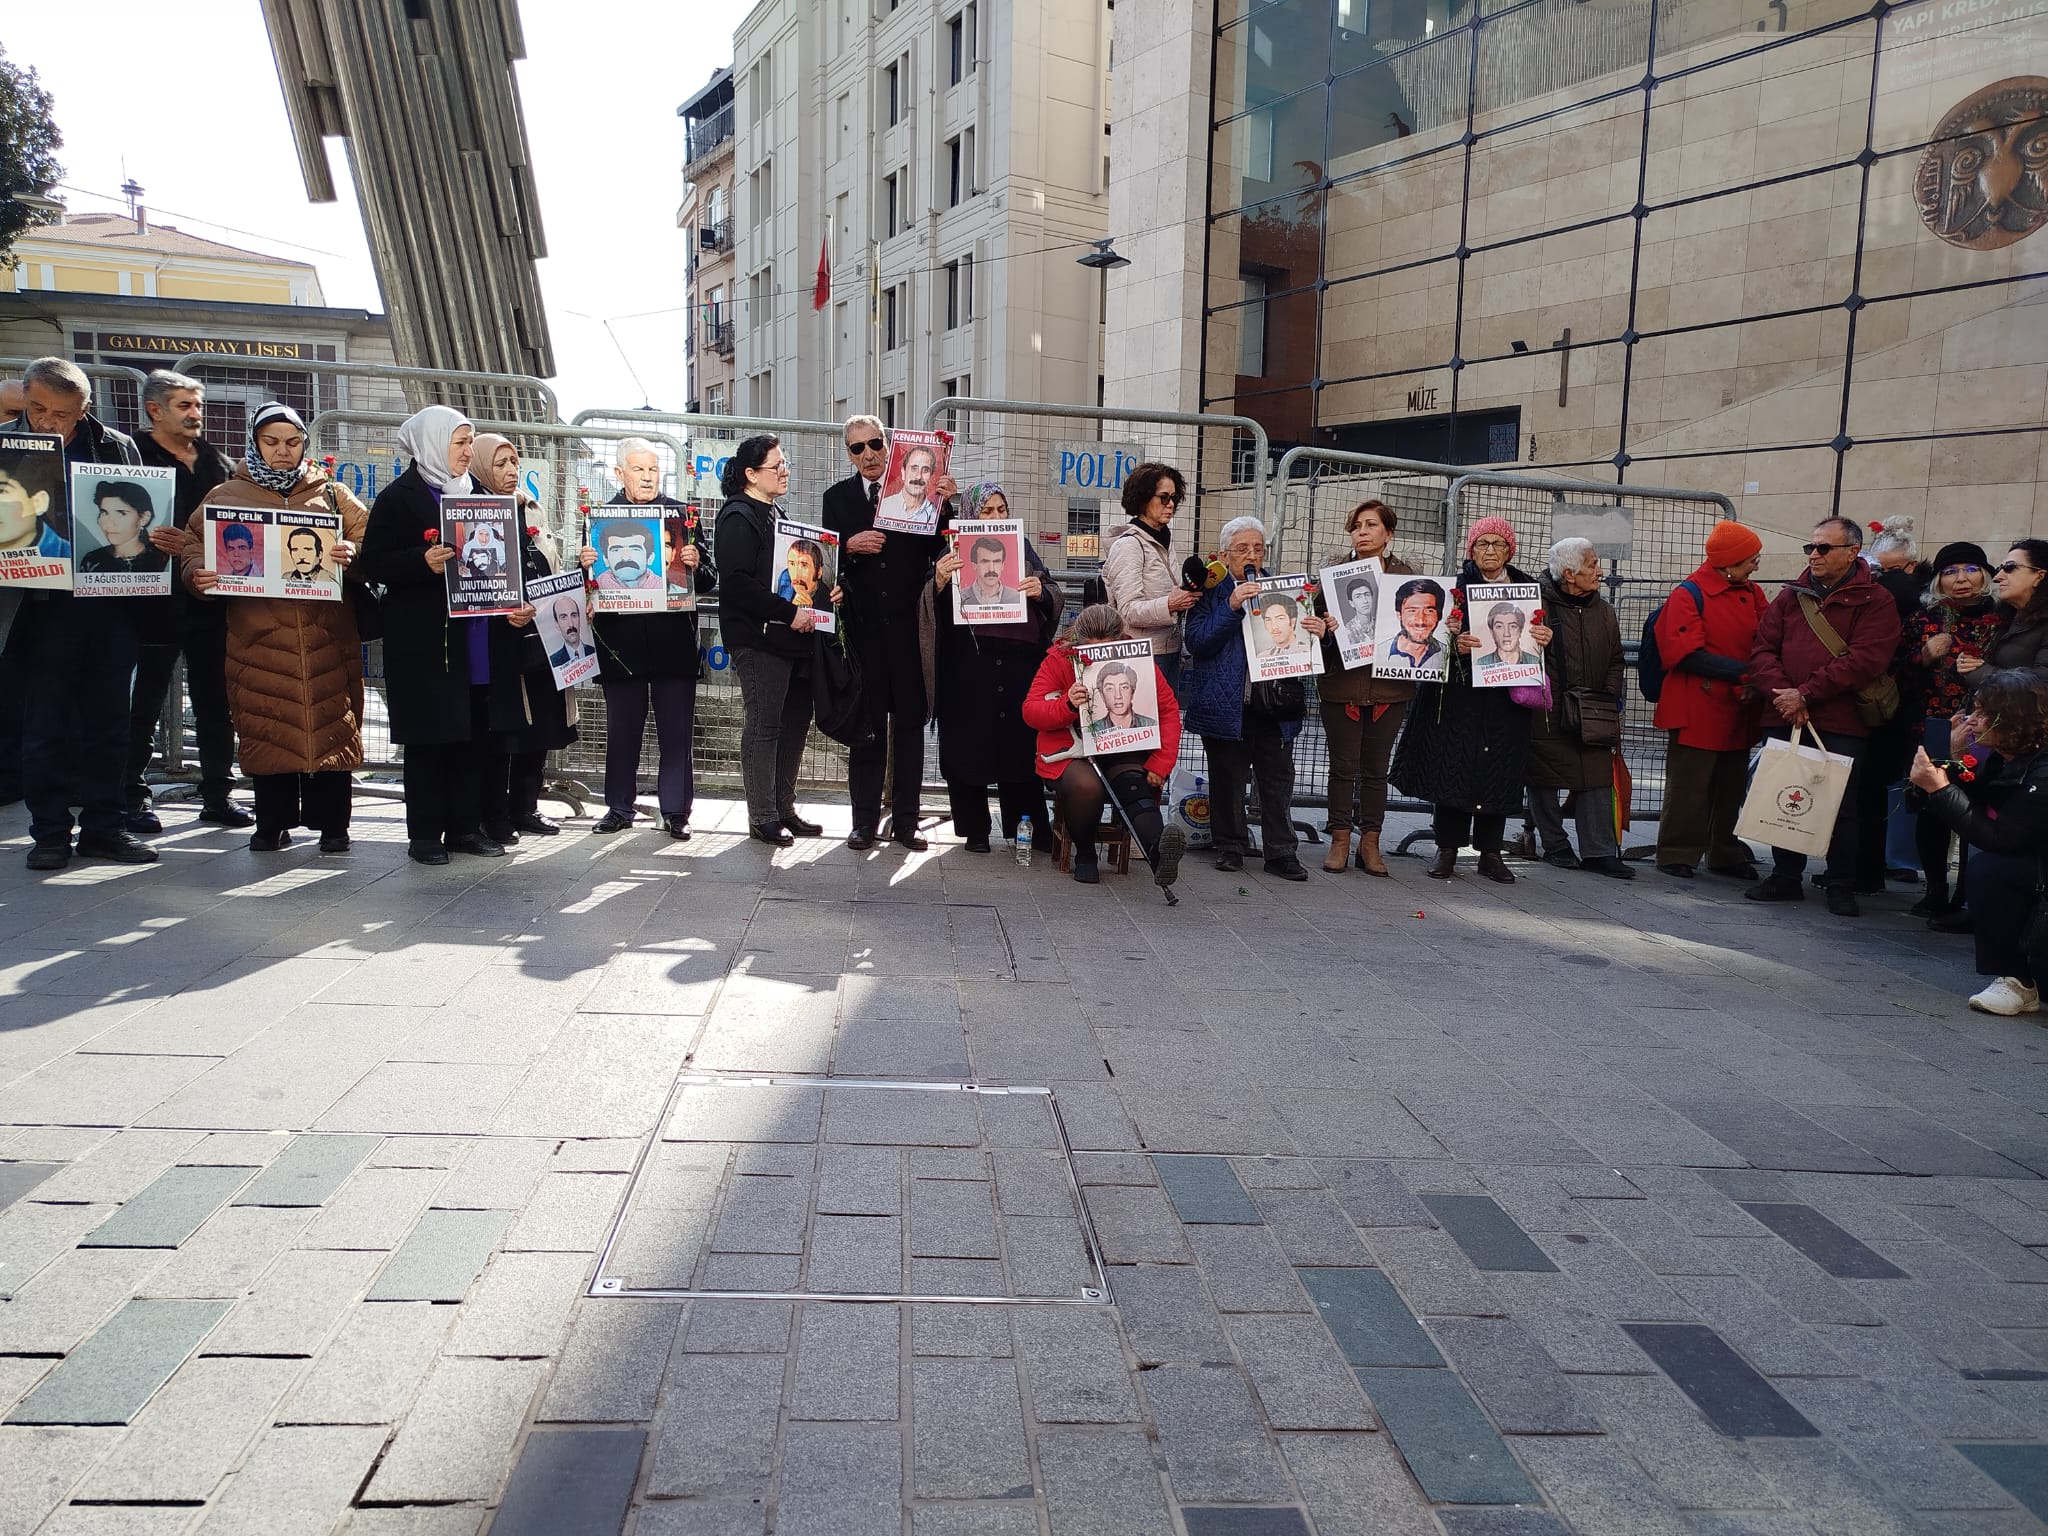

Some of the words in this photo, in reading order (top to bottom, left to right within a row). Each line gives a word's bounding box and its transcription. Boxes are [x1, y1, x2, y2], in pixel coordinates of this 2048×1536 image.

[1892, 11, 1934, 34] YAPI
[109, 335, 240, 354] GALATASARAY
[246, 341, 300, 358] LİSESİ
[1407, 386, 1438, 412] MÜZE
[894, 432, 922, 442] KENAN
[79, 465, 122, 476] RIDDA
[126, 468, 168, 479] YAVUZ
[216, 510, 237, 520] EDİP
[238, 511, 264, 523] ÇELİK
[446, 508, 473, 521] BERFO
[474, 508, 512, 520] KIRBAYIR
[631, 507, 660, 518] DEMİR
[280, 513, 314, 525] İBRAHİM
[314, 516, 336, 527] ÇELİK
[958, 524, 985, 533] FEHMİ
[987, 524, 1018, 532] TOSUN
[84, 574, 93, 584] 15
[94, 573, 132, 584] AĞUSTOS
[134, 574, 161, 583] 1992'DE
[1332, 568, 1355, 578] FERHAT
[126, 583, 169, 595] KAYBEDİLDİ
[215, 583, 265, 594] KAYBEDİLDİ
[459, 578, 507, 591] UNUTMADIN
[526, 580, 554, 599] RIDVAN
[1273, 577, 1305, 590] YILDIZ
[284, 586, 332, 597] KAYBEDİLDİ
[451, 590, 519, 603] UNUTMAYACAĞIZ!
[1471, 587, 1504, 600] MURAT
[1506, 586, 1537, 598] YILDIZ
[598, 597, 653, 609] KAYBEDİLDİ
[1115, 642, 1149, 657] YILDIZ
[1375, 667, 1412, 679] HASAN
[1415, 669, 1444, 681] OCAK
[1483, 665, 1539, 685] KAYBEDİLDİ
[1095, 726, 1154, 753] KAYBEDİLDİ
